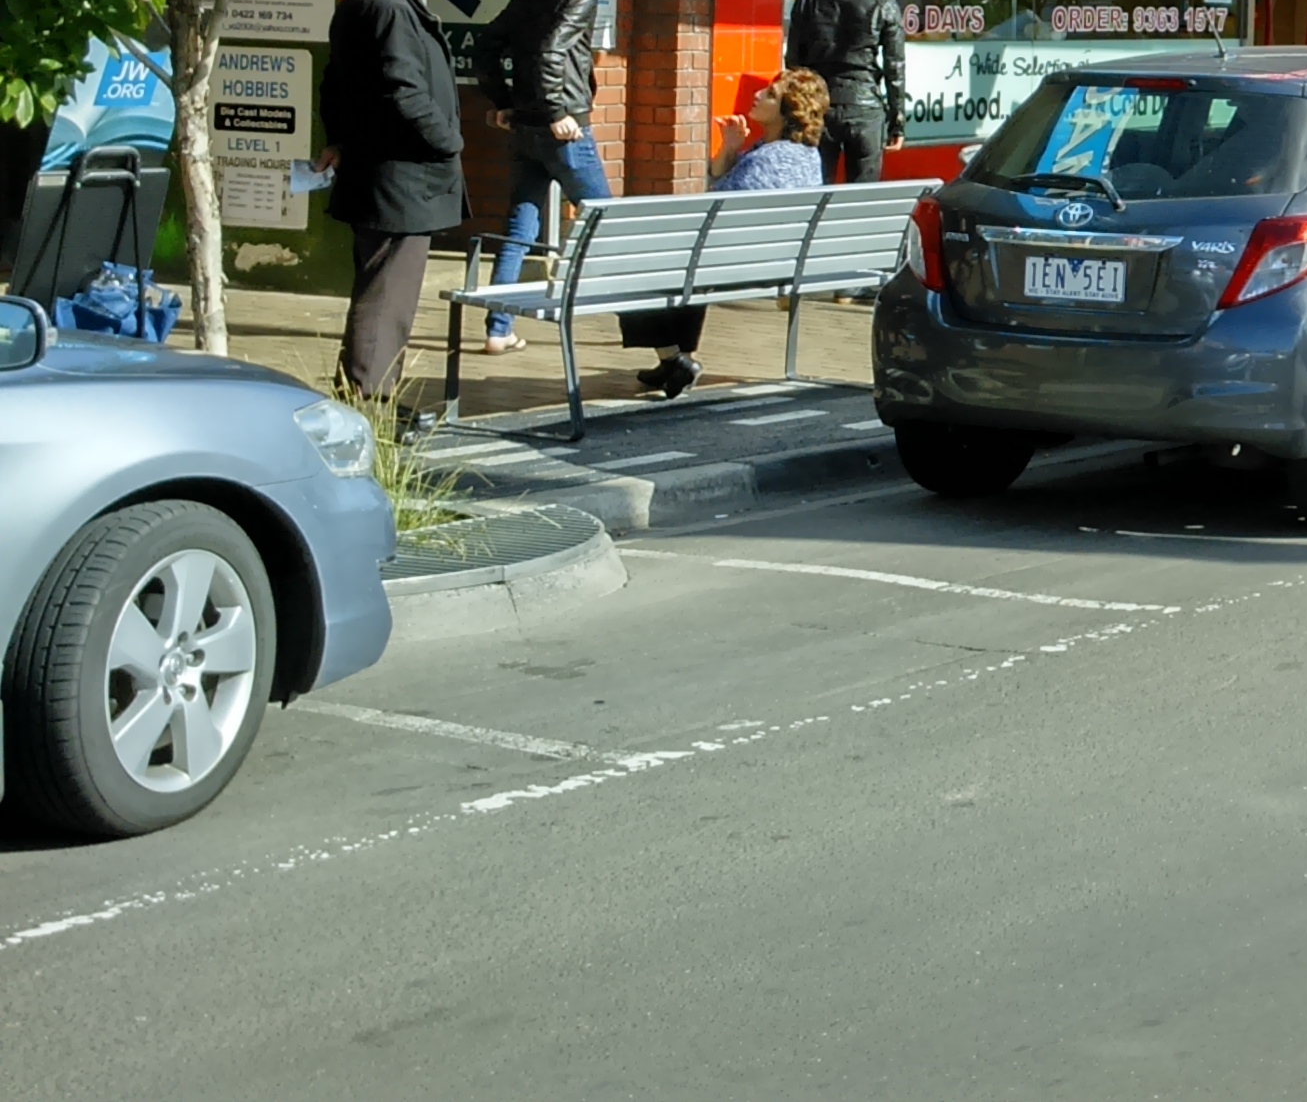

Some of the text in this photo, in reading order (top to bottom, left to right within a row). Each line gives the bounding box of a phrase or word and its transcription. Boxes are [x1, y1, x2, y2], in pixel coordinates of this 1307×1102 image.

[903, 4, 985, 34] 6 DAYS
[1052, 5, 1129, 32] ORDER:
[112, 60, 150, 82] JW
[219, 54, 295, 73] ANDREW'S
[945, 55, 963, 80] A
[103, 83, 146, 99] .ORG
[223, 80, 289, 99] HOBBIES
[260, 109, 292, 119] Models
[227, 138, 281, 152] LEVEL 1
[217, 155, 257, 168] TRADING
[1192, 241, 1236, 254] YARIS
[1031, 262, 1066, 289] 1EN
